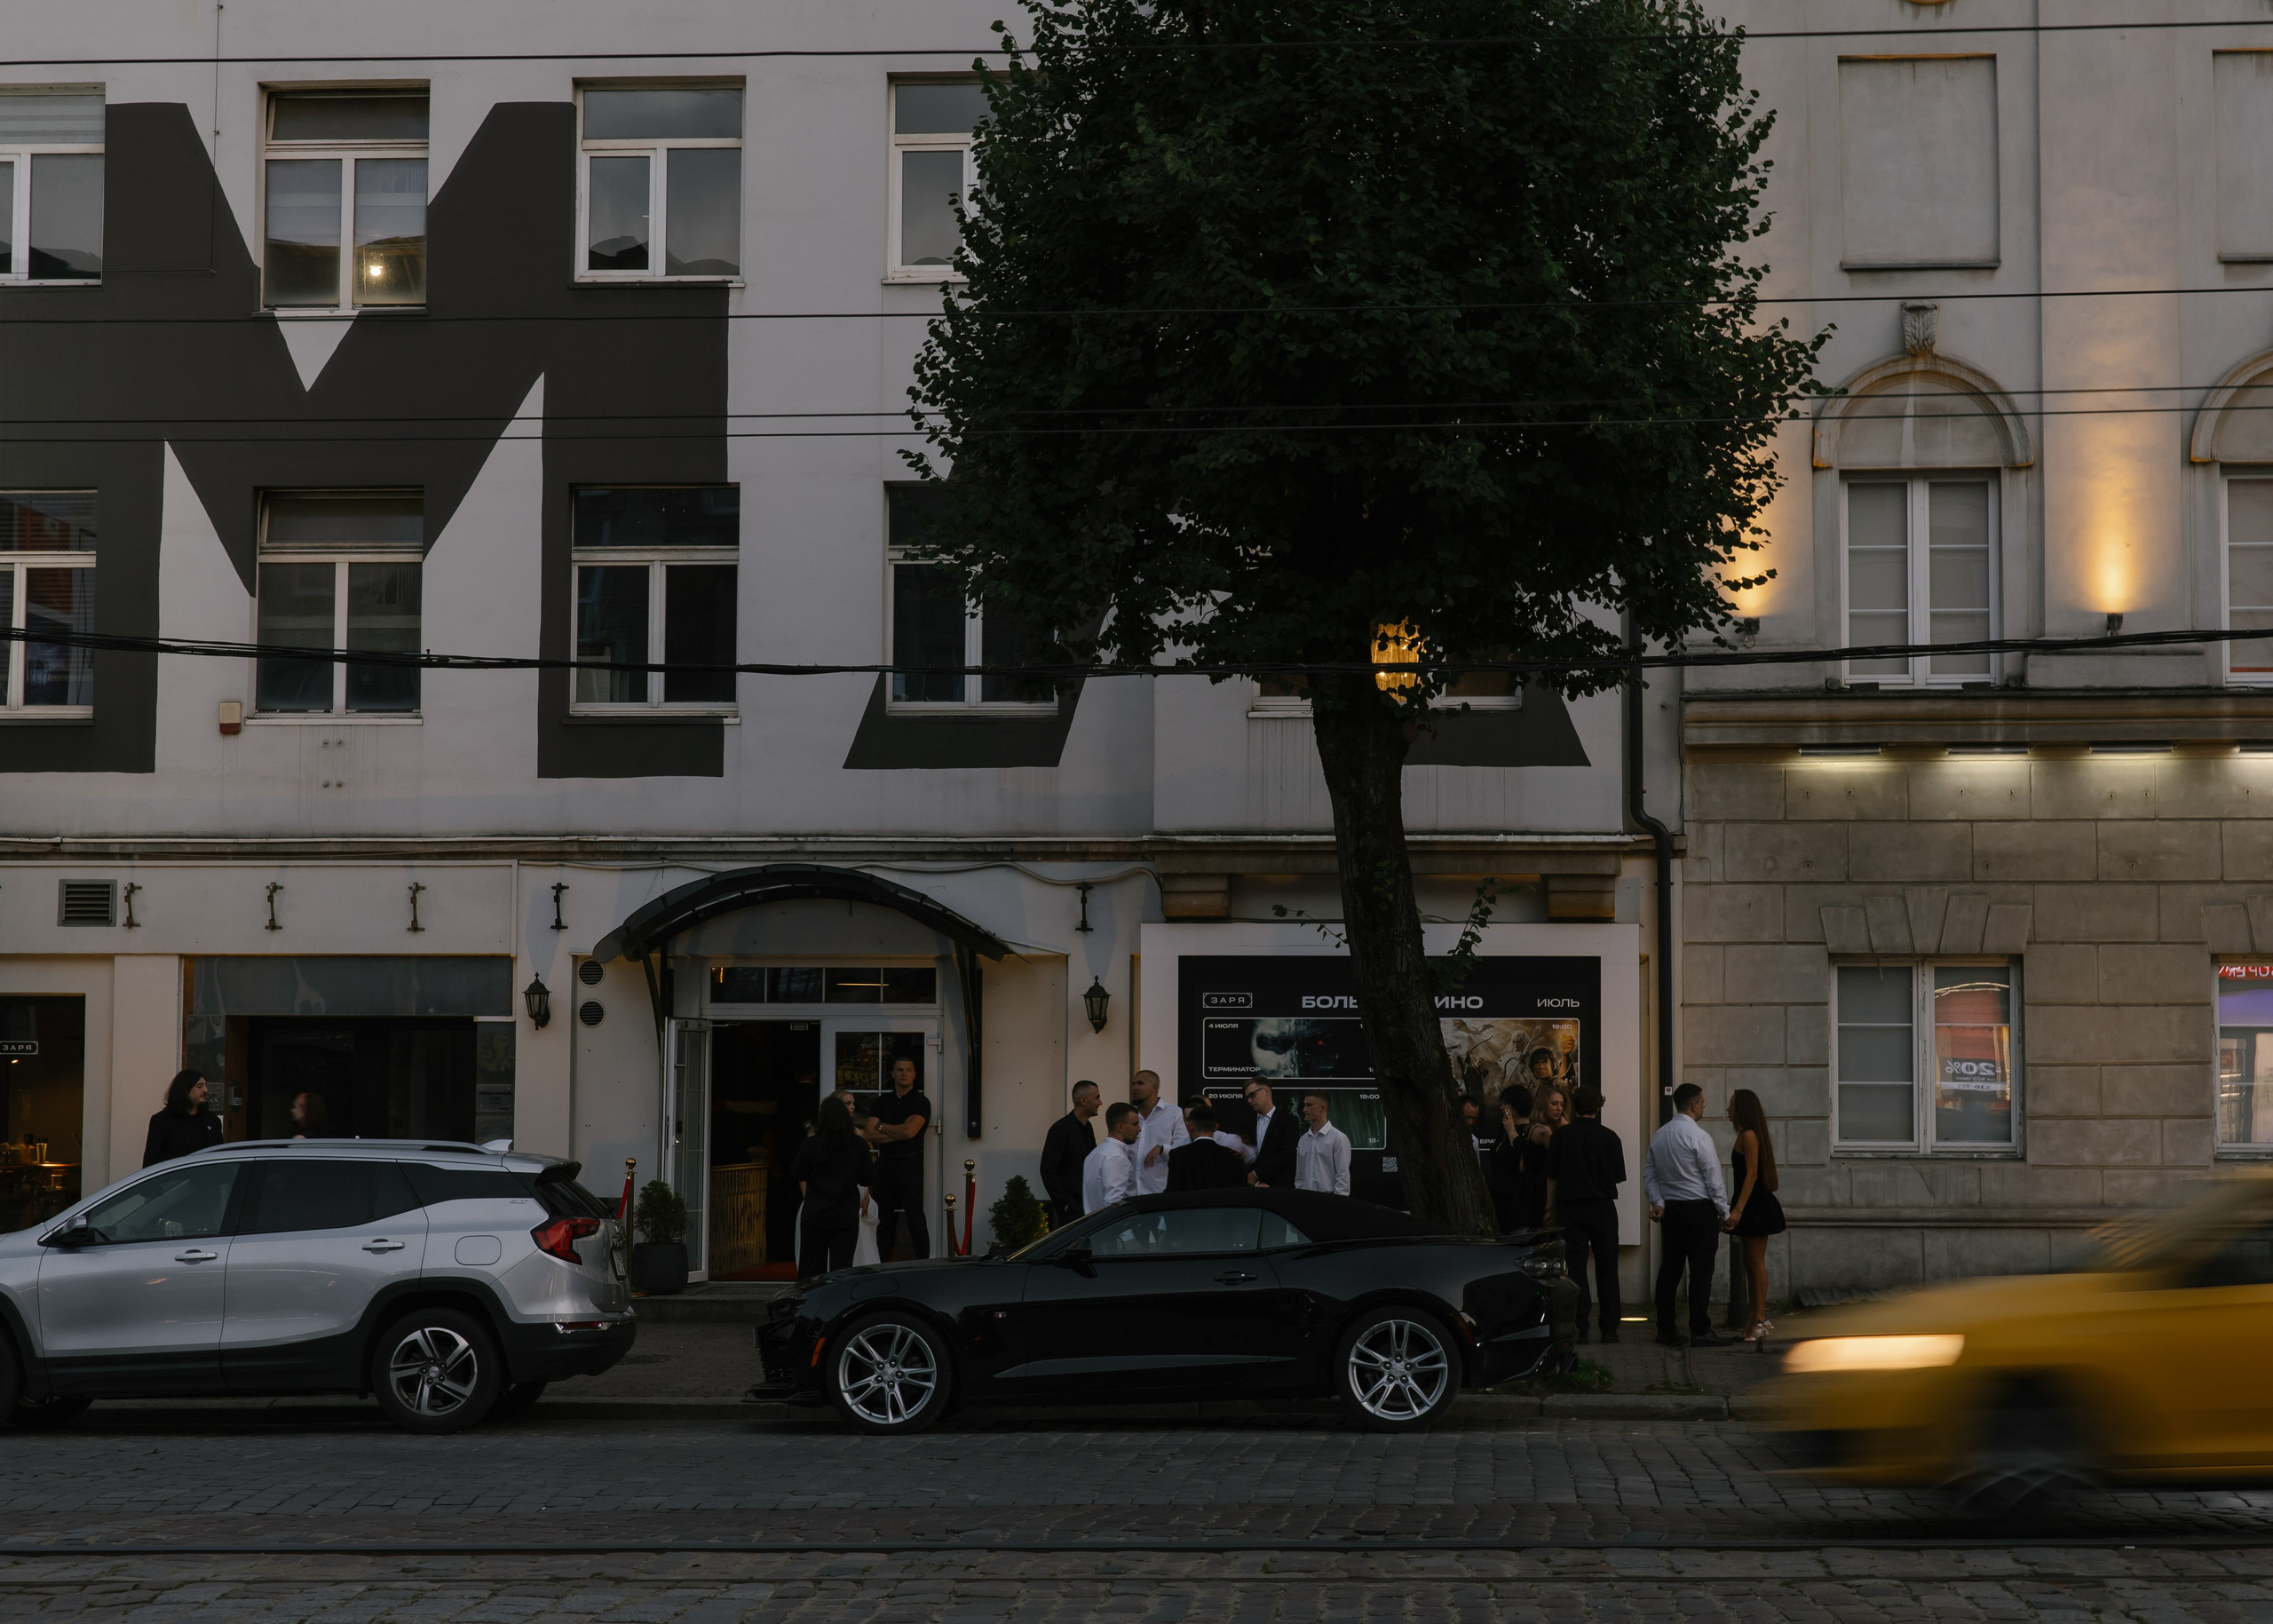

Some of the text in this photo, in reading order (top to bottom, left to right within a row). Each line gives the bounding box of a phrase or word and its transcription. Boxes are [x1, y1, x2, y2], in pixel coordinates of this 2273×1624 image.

[1302, 995, 1484, 1010] БОЛЬ ИНО
[1537, 998, 1580, 1008] ИЮЛЬ
